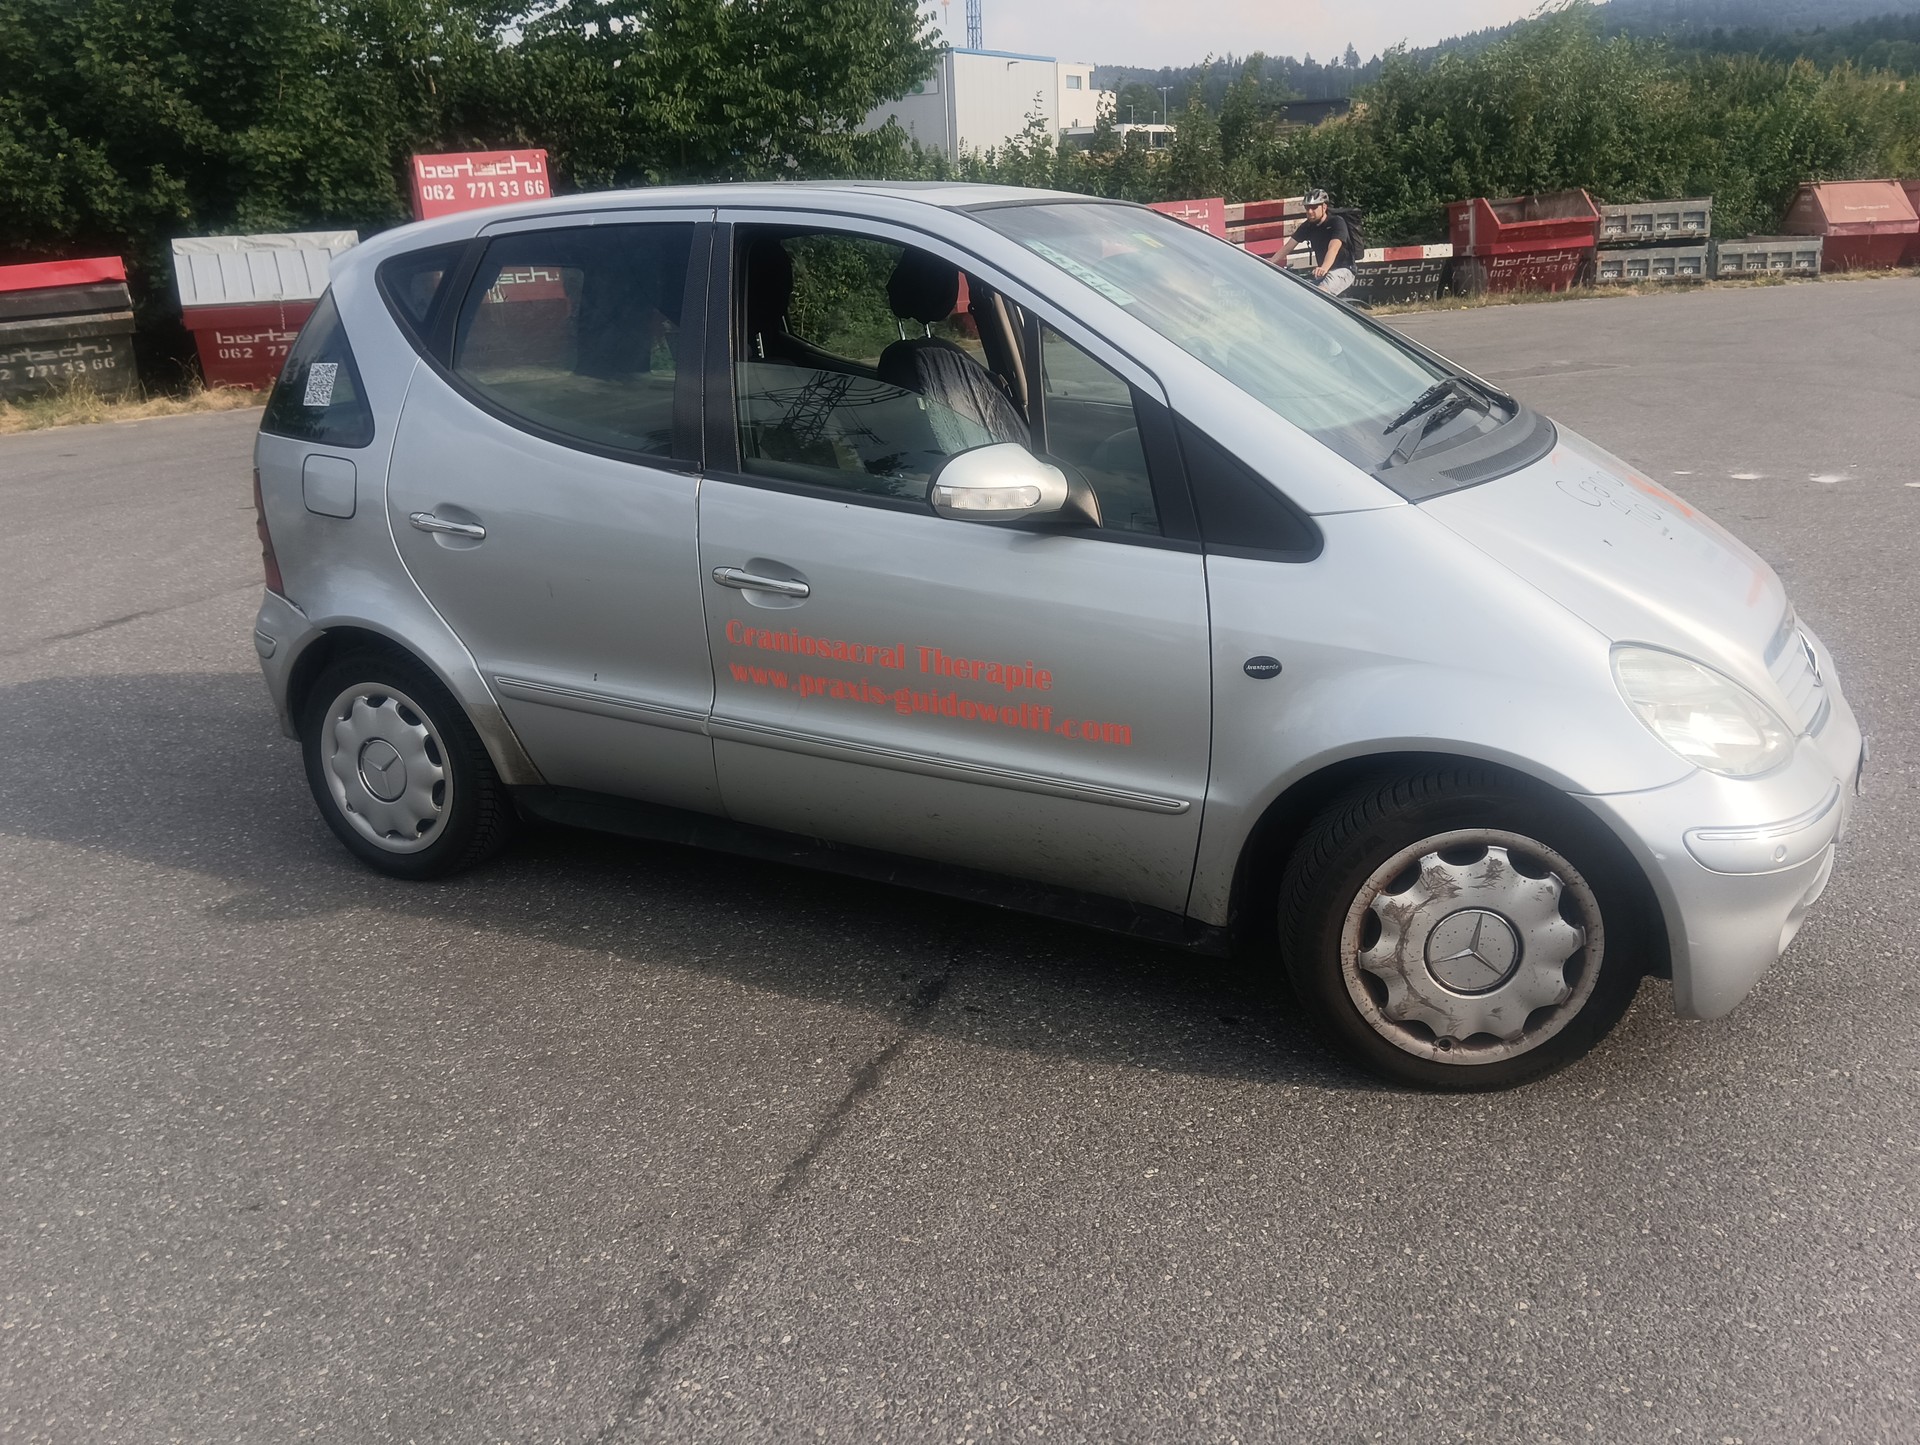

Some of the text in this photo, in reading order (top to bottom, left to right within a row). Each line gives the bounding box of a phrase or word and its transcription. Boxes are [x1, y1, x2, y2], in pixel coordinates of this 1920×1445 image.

[418, 154, 542, 179] bertschi
[423, 179, 546, 201] 062 771 33 66
[1606, 221, 1698, 234] 062 771 33 66
[1492, 250, 1580, 267] bertschi
[1354, 260, 1443, 276] bertschi
[1489, 268, 1514, 279] 062
[1544, 264, 1559, 274] 33
[1561, 262, 1577, 272] 66
[1603, 266, 1694, 278] 062 771 33 66
[1351, 273, 1441, 287] 062 771 33 66
[219, 347, 254, 359] 062
[62, 359, 87, 375] 33
[92, 356, 116, 370] 66
[726, 618, 1053, 693] Craniosacral Therapie
[729, 662, 1133, 746] www.praxis-guidowolff.com
